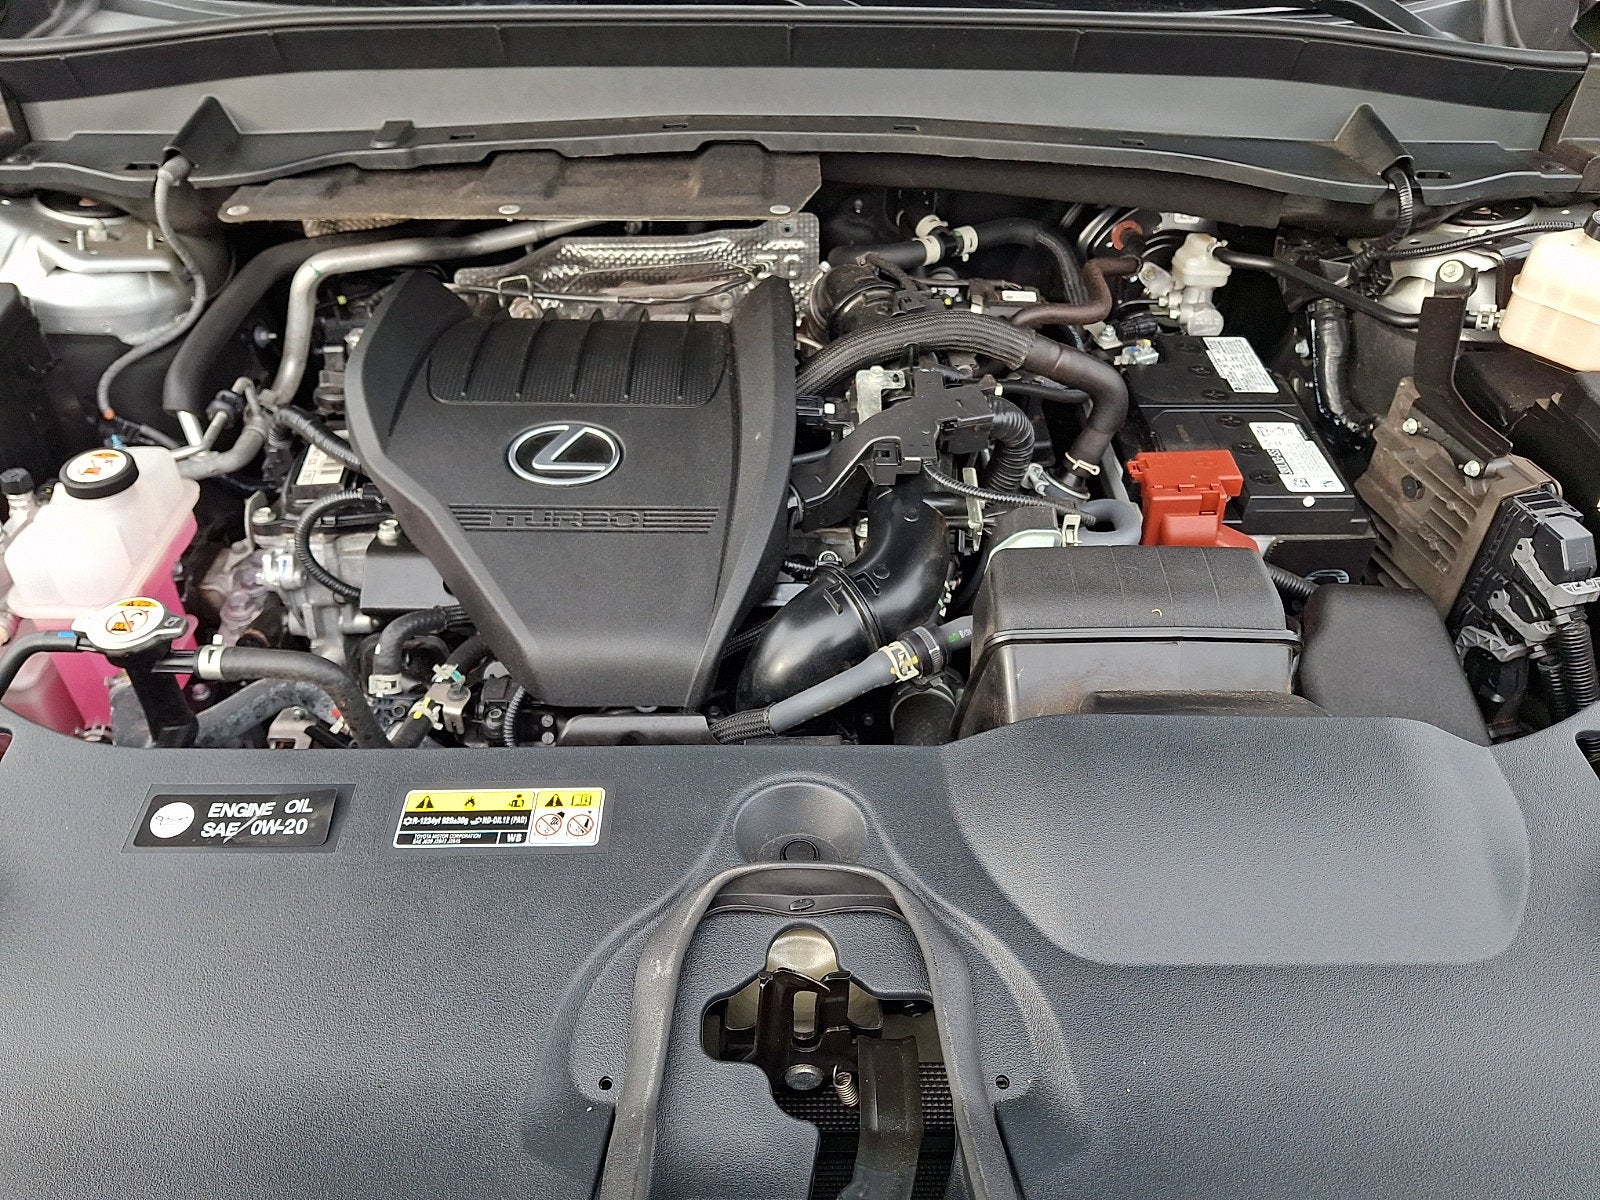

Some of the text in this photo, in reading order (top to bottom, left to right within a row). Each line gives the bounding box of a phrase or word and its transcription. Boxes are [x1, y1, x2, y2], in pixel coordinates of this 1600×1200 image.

[495, 509, 641, 528] TURBO
[207, 798, 313, 818] ENGINE OIL
[201, 818, 308, 838] SAE 0W-20
